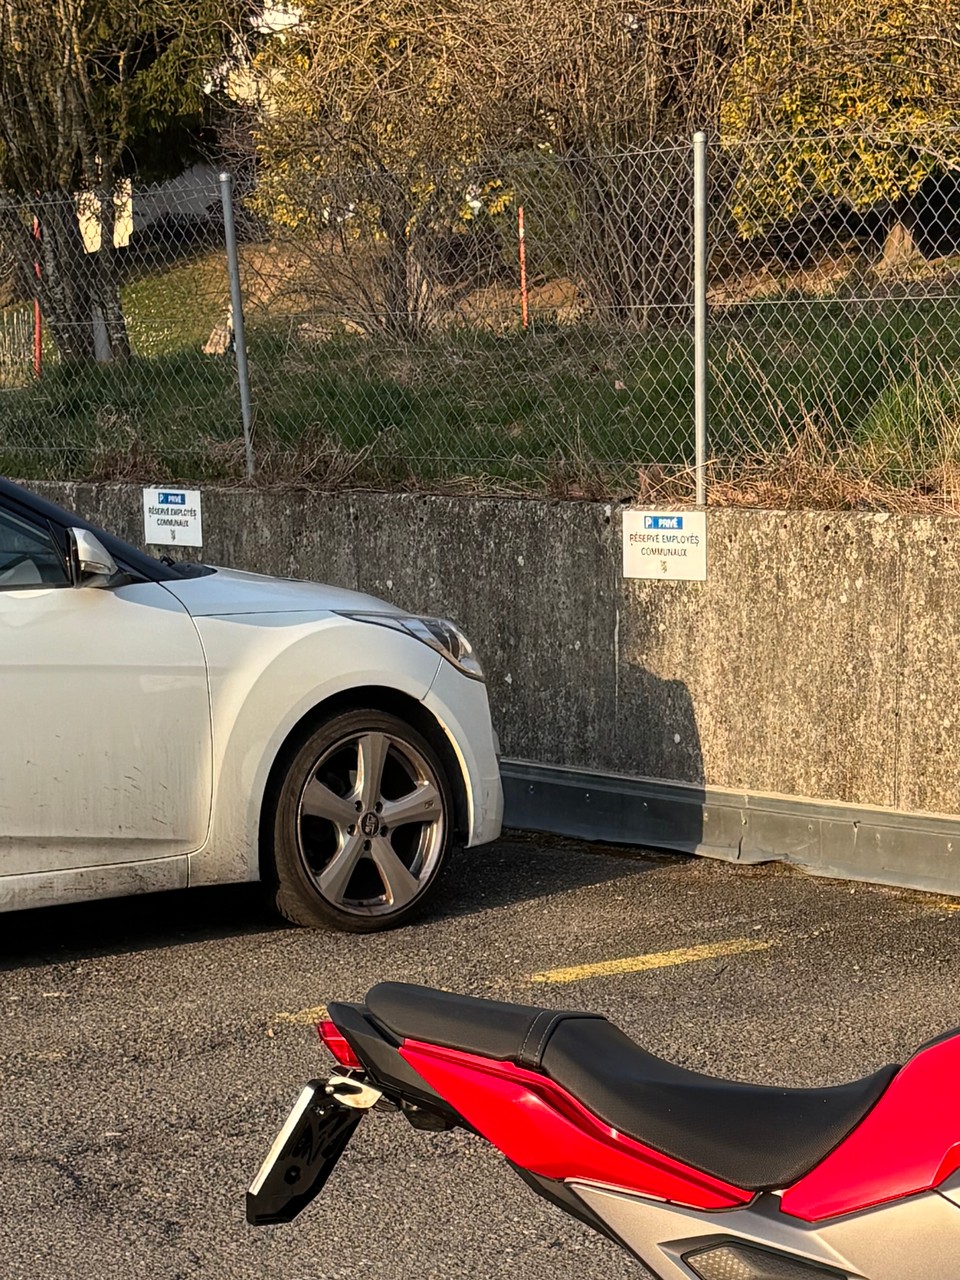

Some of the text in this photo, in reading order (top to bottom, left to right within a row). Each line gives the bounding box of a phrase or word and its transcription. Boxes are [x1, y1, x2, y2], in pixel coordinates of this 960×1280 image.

[645, 516, 679, 528] P PRIVÉ
[629, 532, 700, 545] RÉSERVÉ EMPLOYÉS
[640, 547, 688, 557] COMMUNAUX
